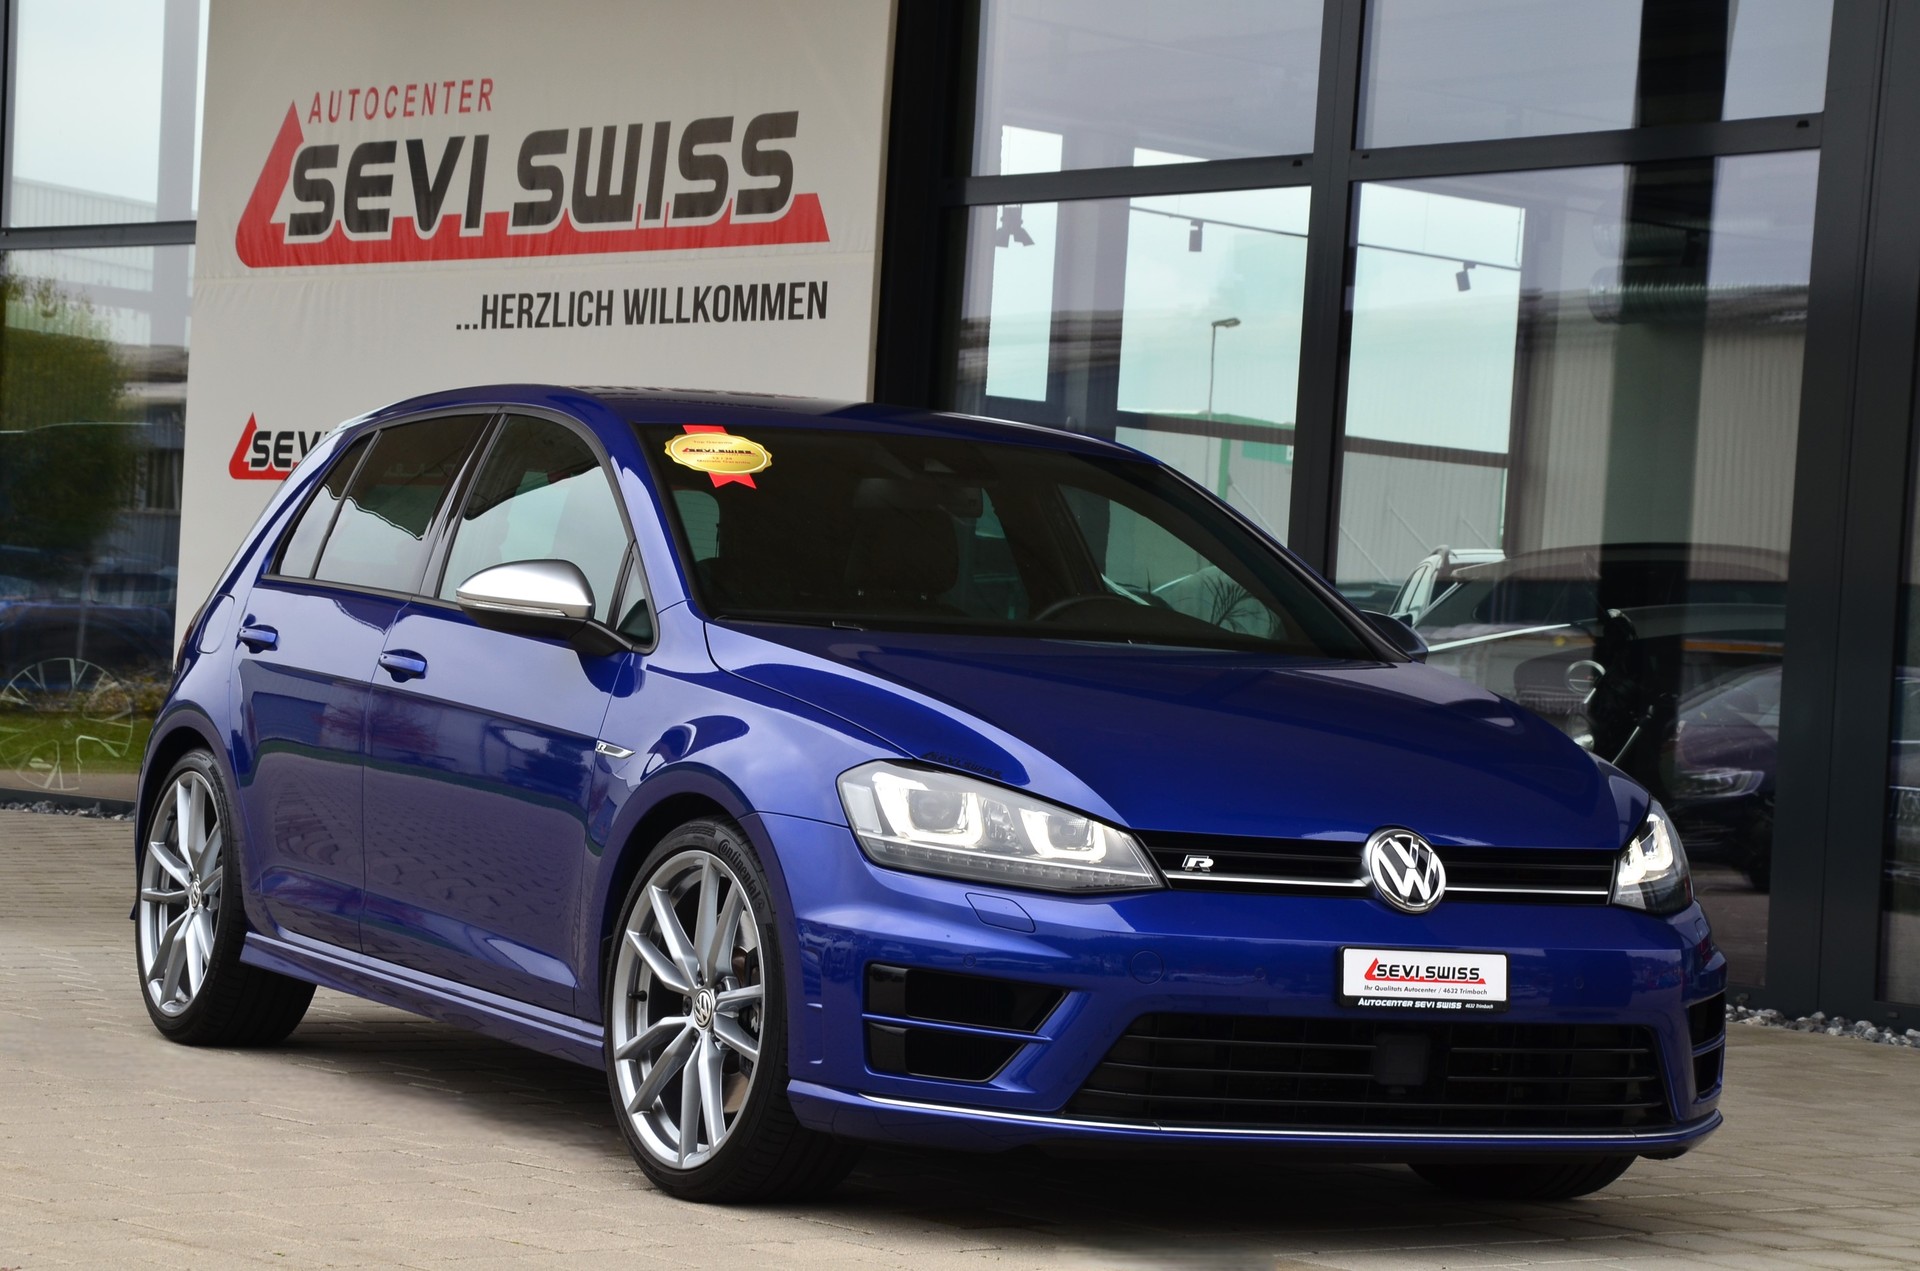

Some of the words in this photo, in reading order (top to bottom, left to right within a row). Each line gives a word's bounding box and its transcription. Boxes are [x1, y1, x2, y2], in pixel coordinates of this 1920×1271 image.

[307, 78, 494, 123] AUTOCENTER
[287, 133, 490, 238] SEVI
[512, 110, 800, 233] SWISS
[455, 290, 614, 331] ...HERZLICH
[623, 280, 829, 326] WILLKOMMEN
[249, 430, 329, 468] SEV
[718, 839, 761, 901] Continental
[1182, 854, 1214, 872] R
[1376, 963, 1420, 979] SEVI
[1425, 965, 1480, 981] SWISS
[1403, 986, 1437, 994] Autocenter
[1460, 988, 1488, 996] Trimbach
[1358, 997, 1414, 1008] AUTOCENTER
[1415, 1001, 1435, 1009] SEVI
[1436, 1001, 1462, 1009] SWISS
